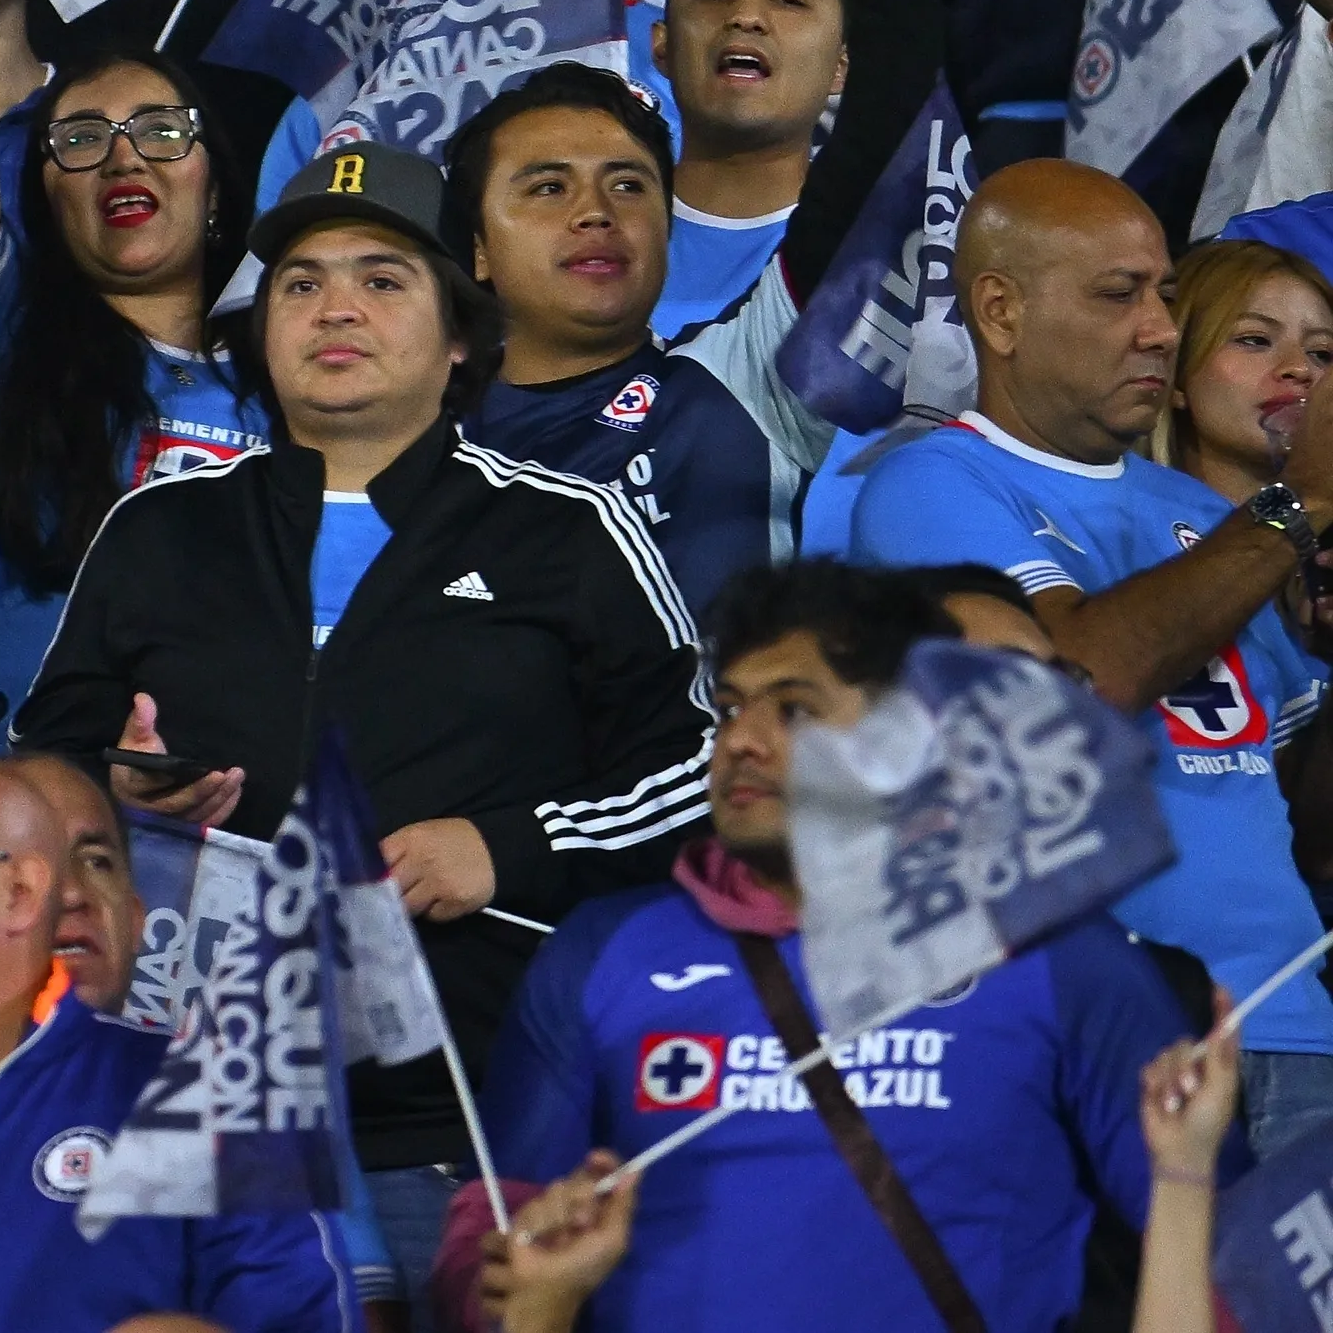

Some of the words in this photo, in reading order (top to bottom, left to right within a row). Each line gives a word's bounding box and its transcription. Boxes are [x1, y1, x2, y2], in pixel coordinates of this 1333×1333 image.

[158, 416, 264, 449] EMENTO
[1176, 752, 1238, 775] CRUZ
[263, 949, 333, 1133] QUE
[726, 1027, 951, 1071] CEENTO
[720, 1073, 815, 1112] CRU
